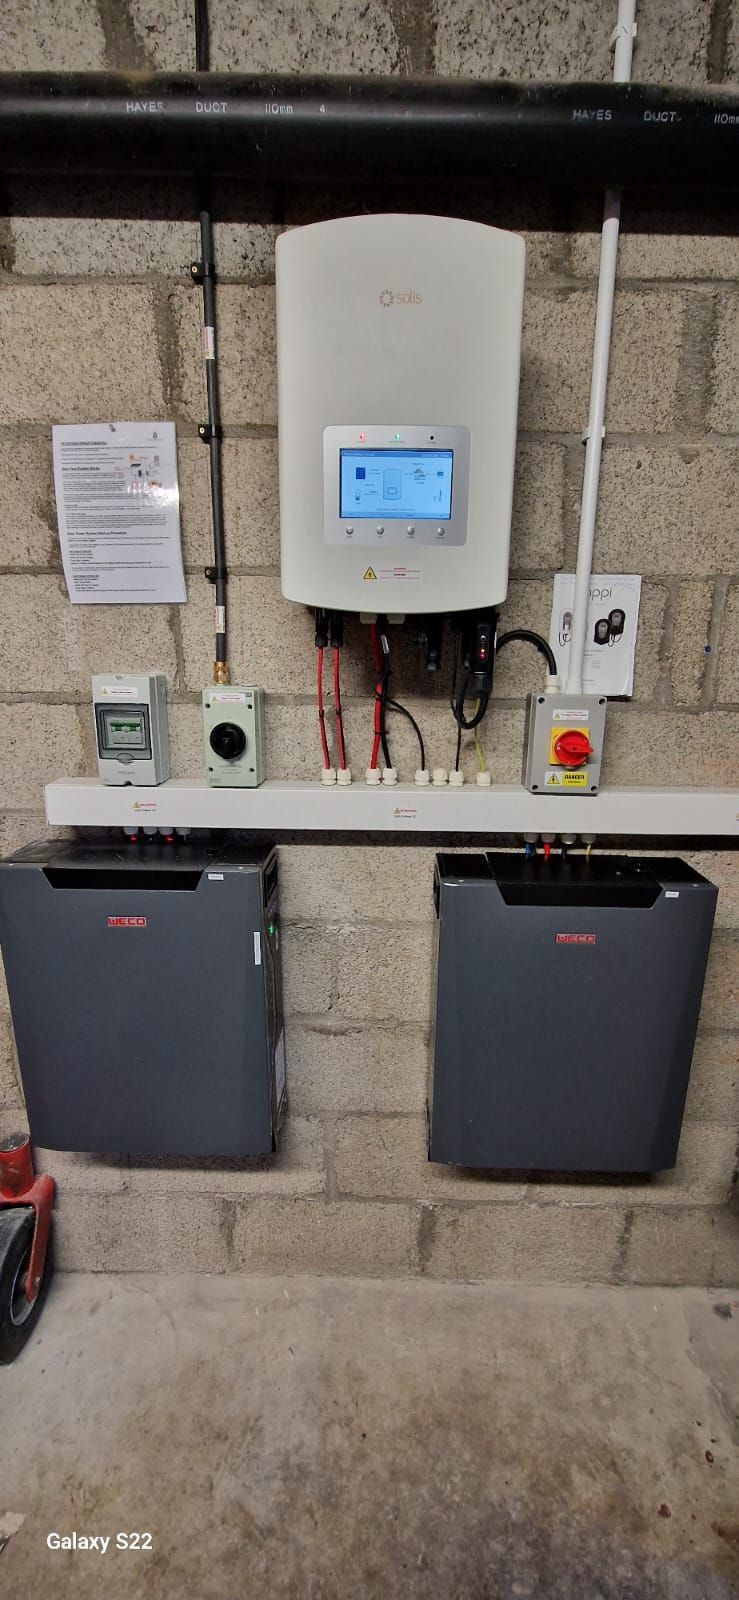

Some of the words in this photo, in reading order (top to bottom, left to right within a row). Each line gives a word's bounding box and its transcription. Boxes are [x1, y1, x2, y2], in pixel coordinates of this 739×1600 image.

[126, 101, 164, 112] HAYES
[195, 102, 228, 113] DUCT
[265, 103, 293, 114] 110mm
[571, 109, 612, 121] HAYES
[643, 110, 677, 122] DUCT
[396, 290, 423, 305] solis
